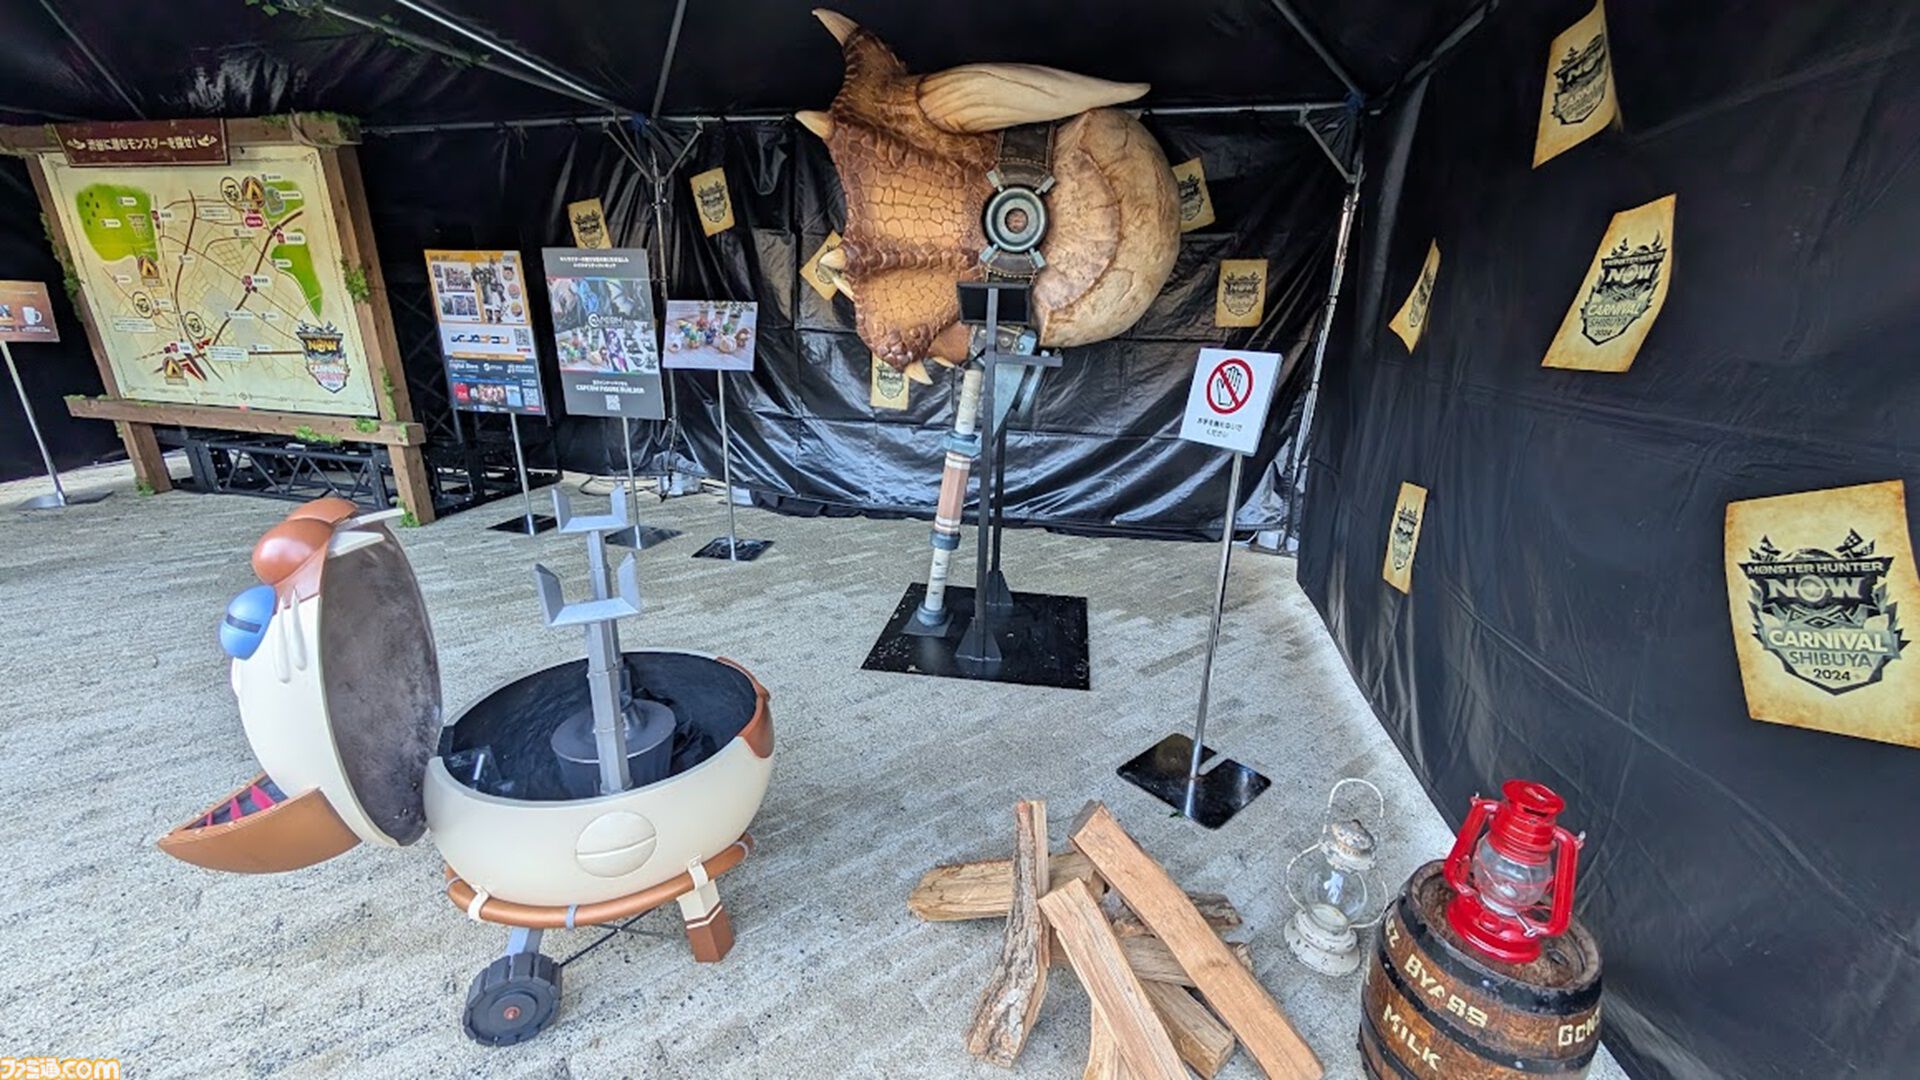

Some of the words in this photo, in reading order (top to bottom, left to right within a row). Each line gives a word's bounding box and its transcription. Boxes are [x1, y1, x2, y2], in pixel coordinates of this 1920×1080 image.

[1606, 263, 1655, 284] NOW
[1587, 301, 1642, 316] CARNIVAL
[307, 339, 337, 352] NOW
[1747, 562, 1815, 575] MONSTER
[1817, 561, 1884, 573] HUNTER
[1764, 574, 1863, 602] NOW
[1768, 630, 1889, 652] CARNIVAL
[1789, 651, 1873, 668] SHIBUYA
[1812, 668, 1851, 681] 2024
[1383, 1003, 1442, 1072] MILK
